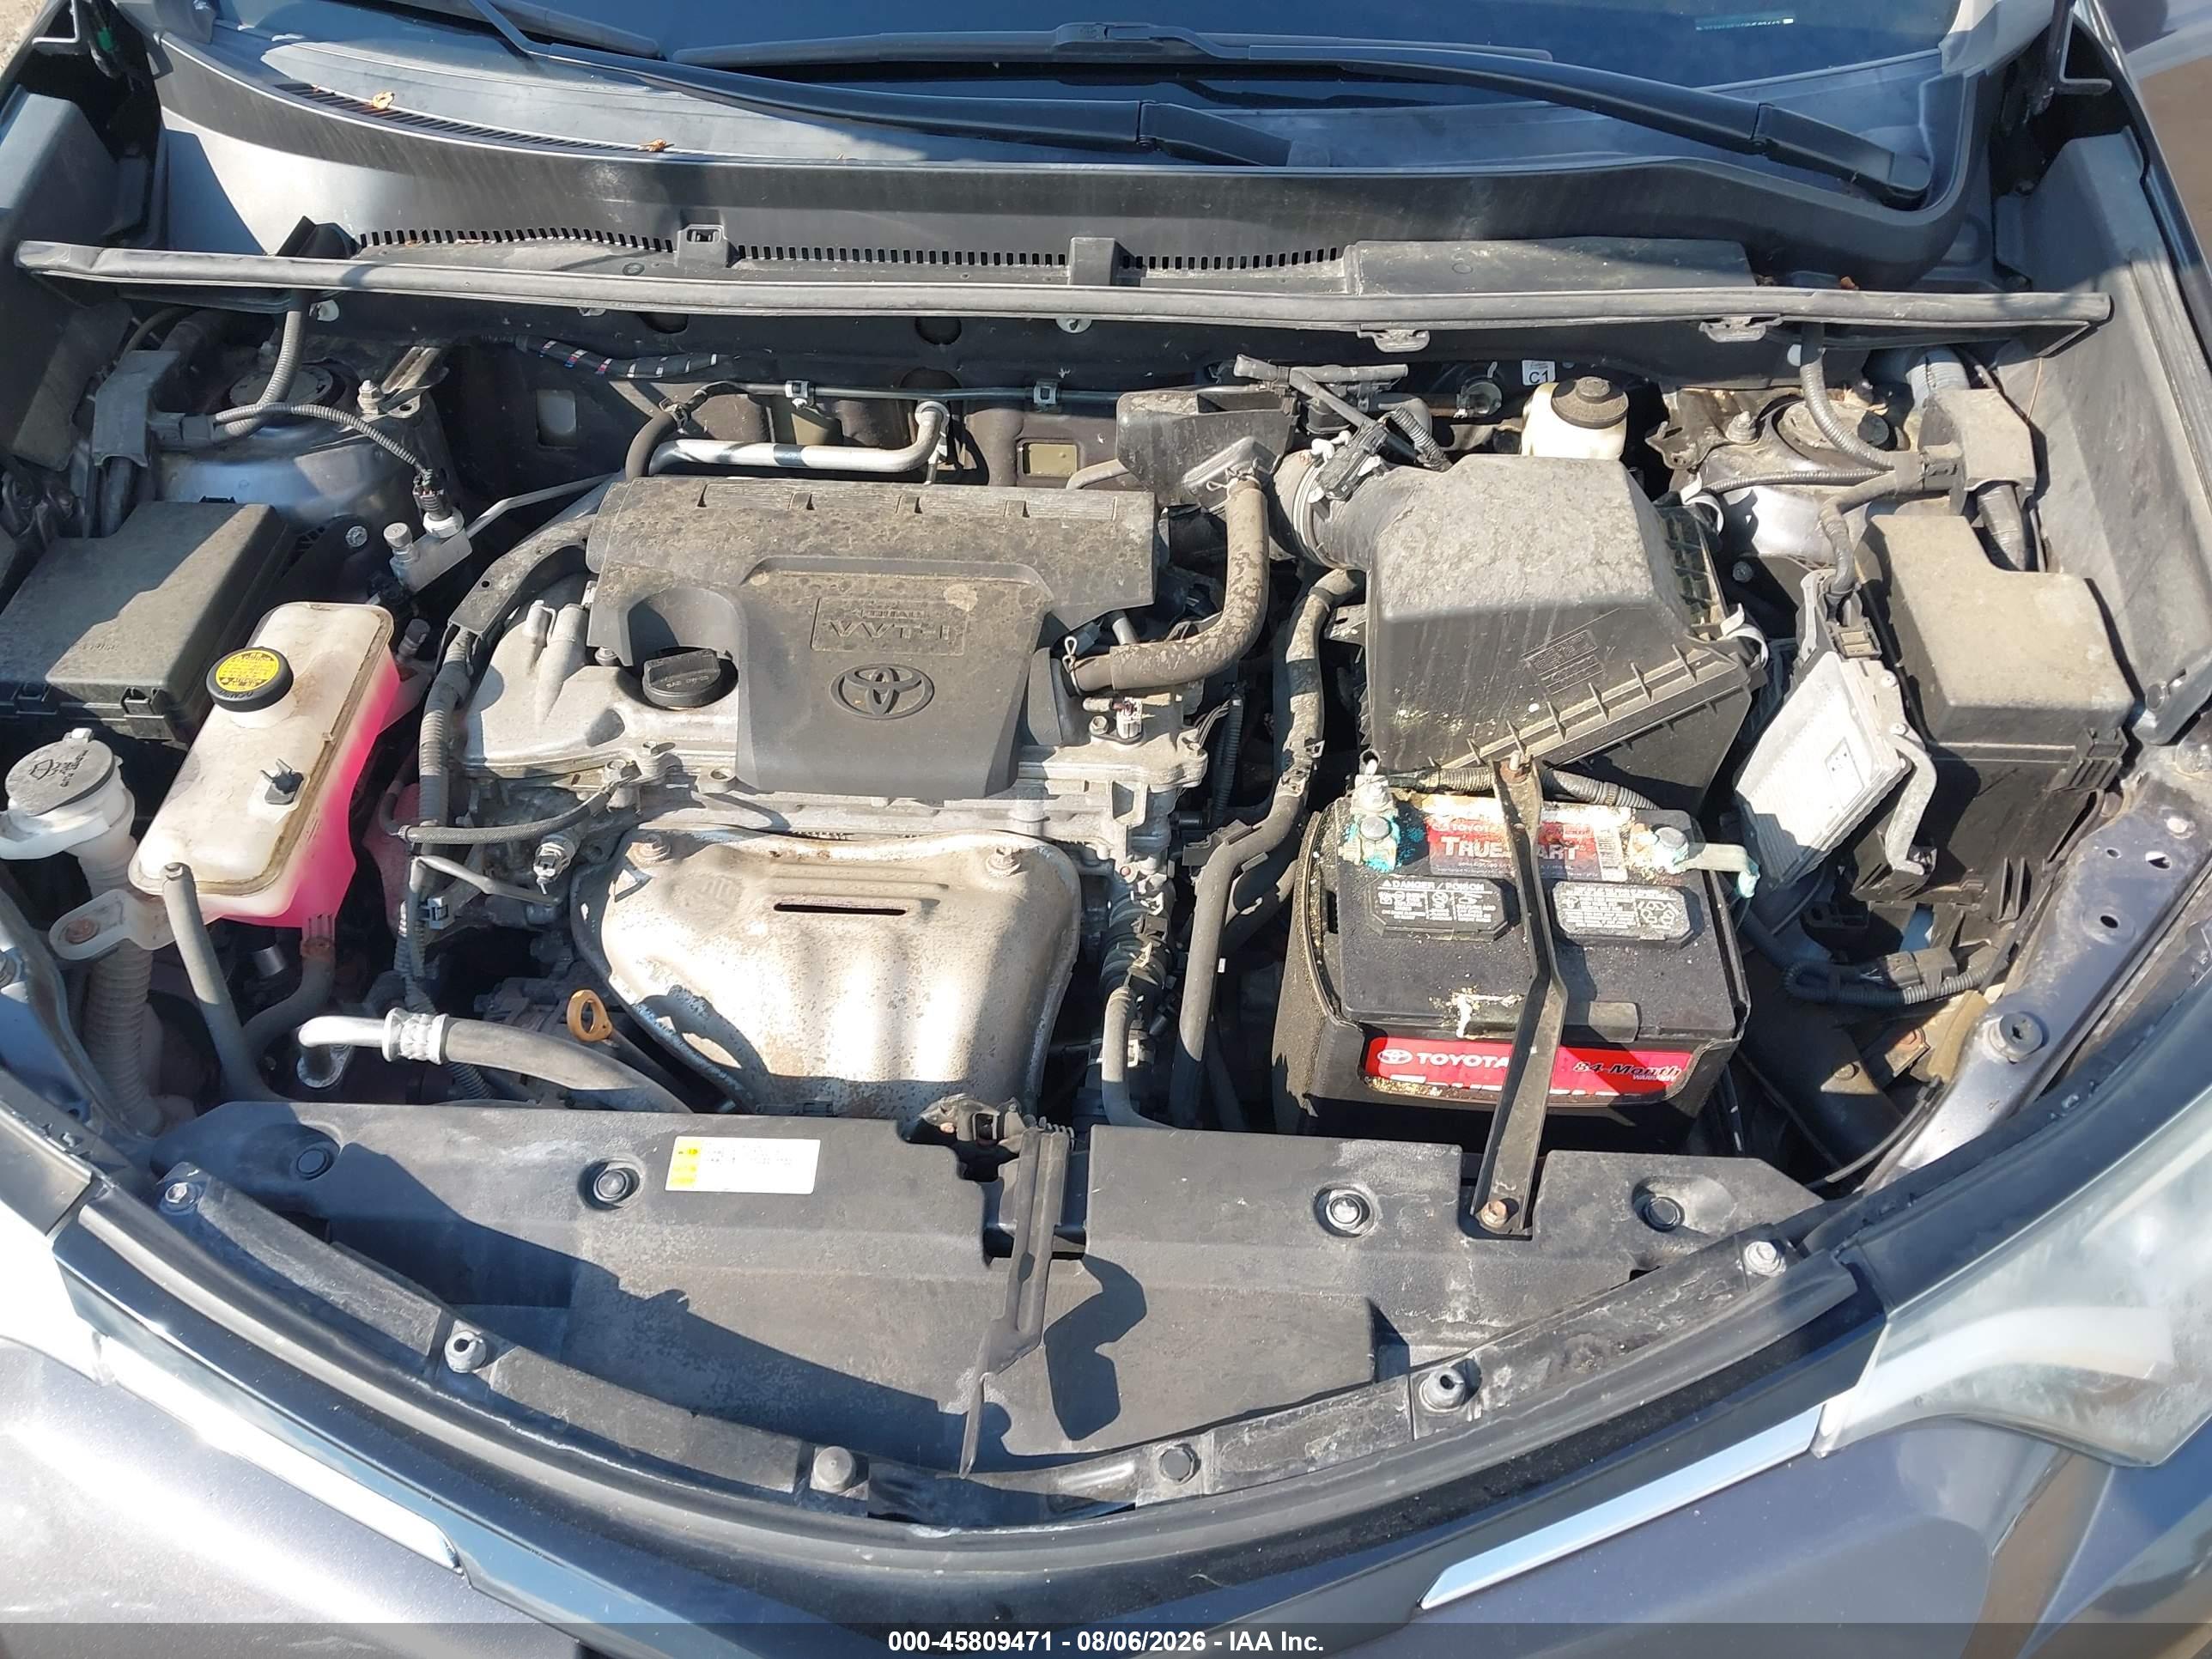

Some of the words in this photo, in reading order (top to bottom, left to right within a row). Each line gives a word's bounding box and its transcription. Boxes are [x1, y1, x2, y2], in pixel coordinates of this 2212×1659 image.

[1529, 370, 1548, 384] C1
[1392, 879, 1436, 890] DANGER
[1416, 1052, 1510, 1068] TOYOTA
